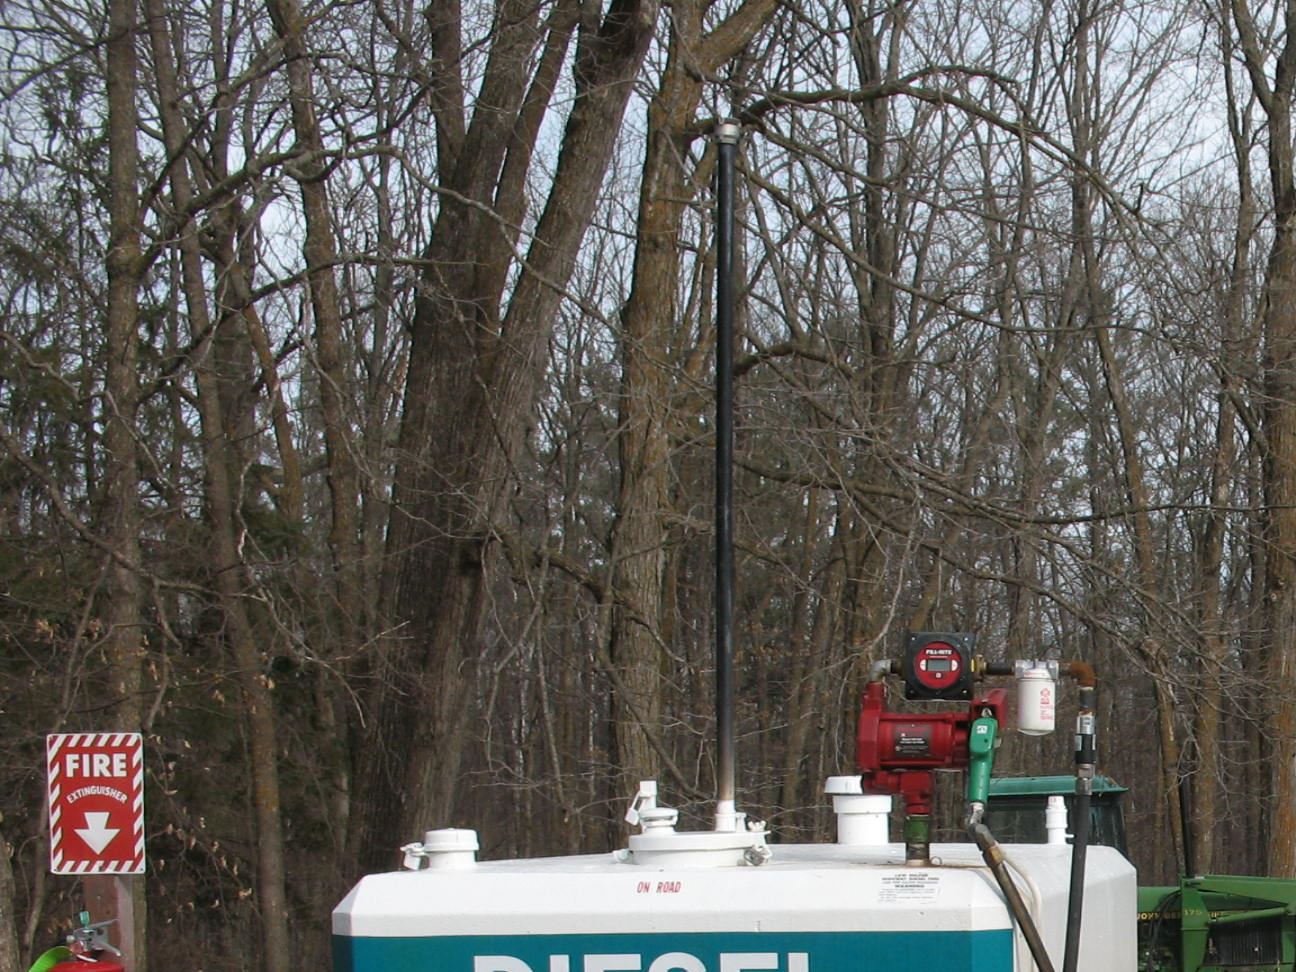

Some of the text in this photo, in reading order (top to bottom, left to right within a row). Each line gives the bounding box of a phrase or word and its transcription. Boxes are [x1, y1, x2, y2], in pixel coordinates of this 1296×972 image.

[65, 752, 128, 778] FIRE
[66, 785, 129, 804] EXTINGUISHER
[636, 881, 682, 894] ON ROAD
